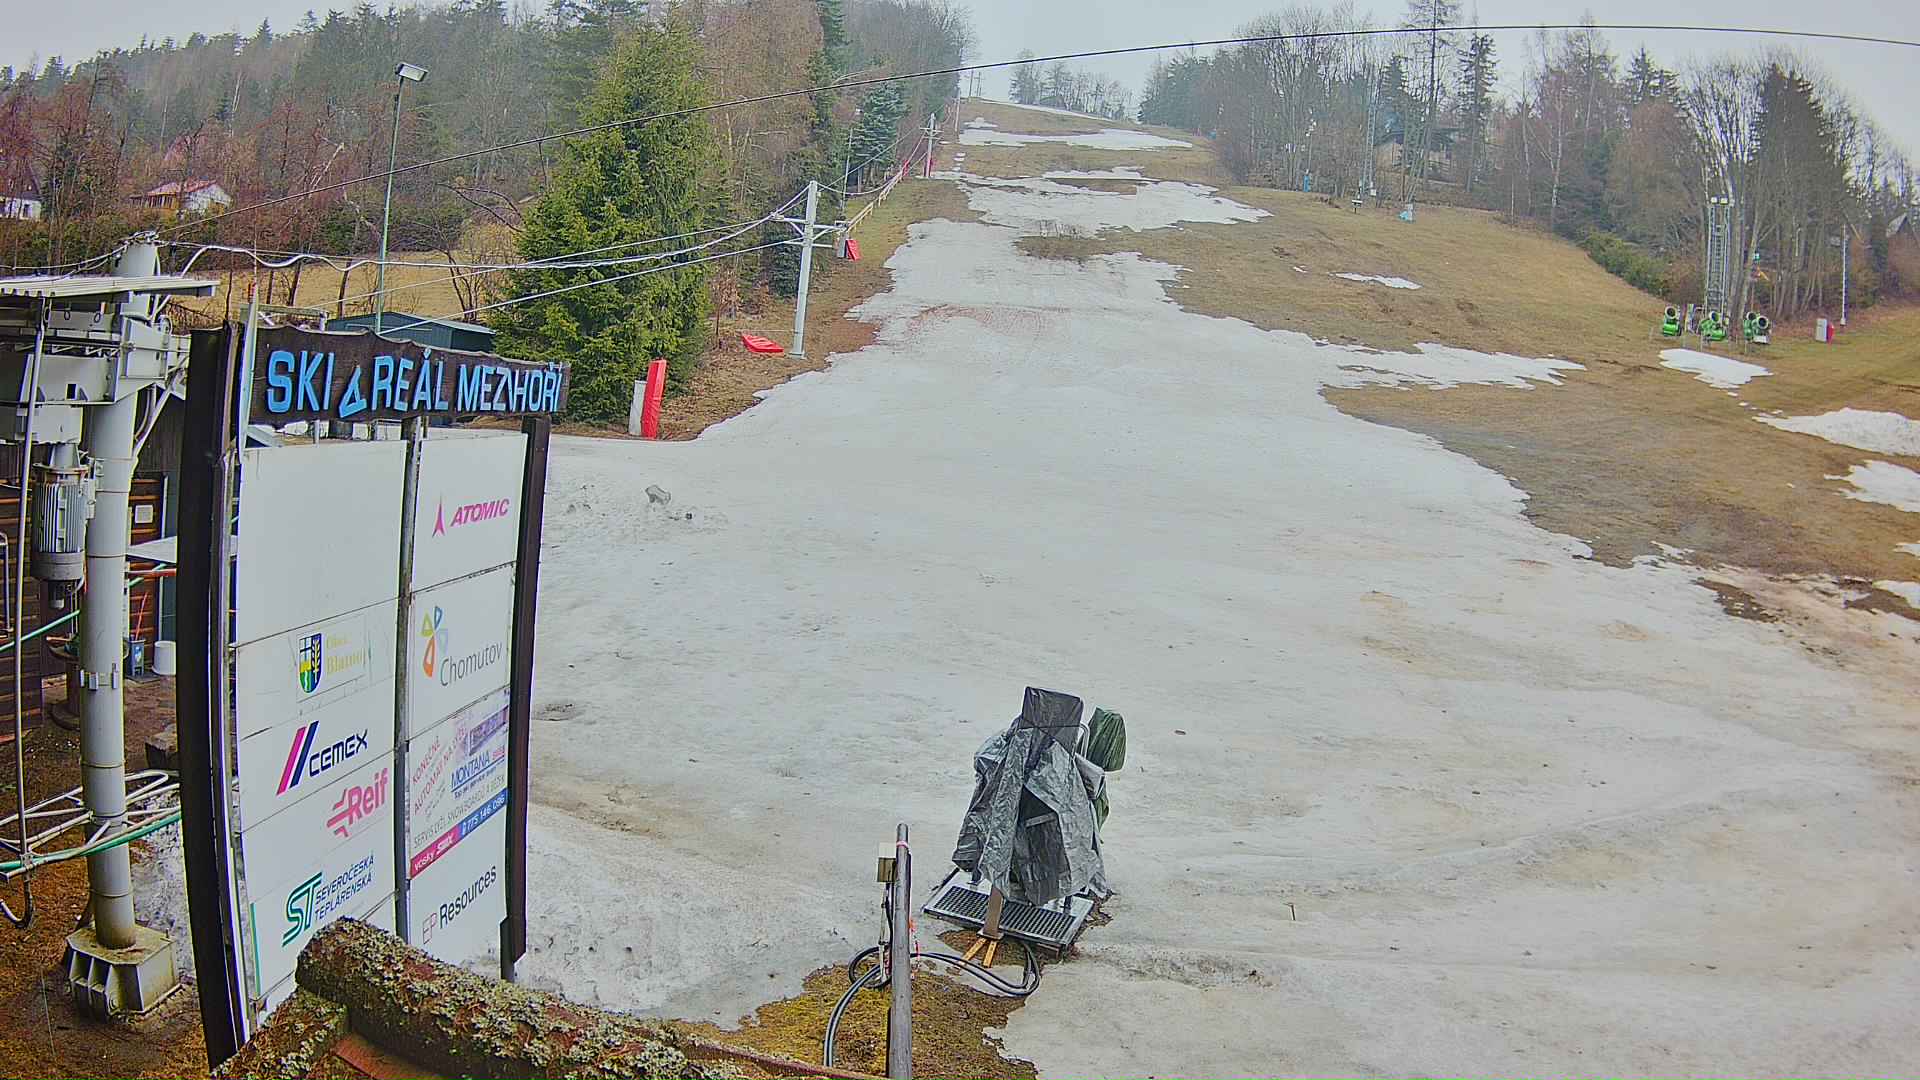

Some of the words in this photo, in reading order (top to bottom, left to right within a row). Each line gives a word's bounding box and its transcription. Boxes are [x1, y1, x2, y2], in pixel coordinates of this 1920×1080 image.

[266, 350, 336, 414] SKI
[450, 498, 510, 528] ATOMIC
[440, 641, 503, 687] Chomutov
[309, 728, 368, 778] CEMEX
[451, 750, 490, 792] MONTANA
[347, 767, 389, 826] Reif
[439, 865, 497, 930] Resources
